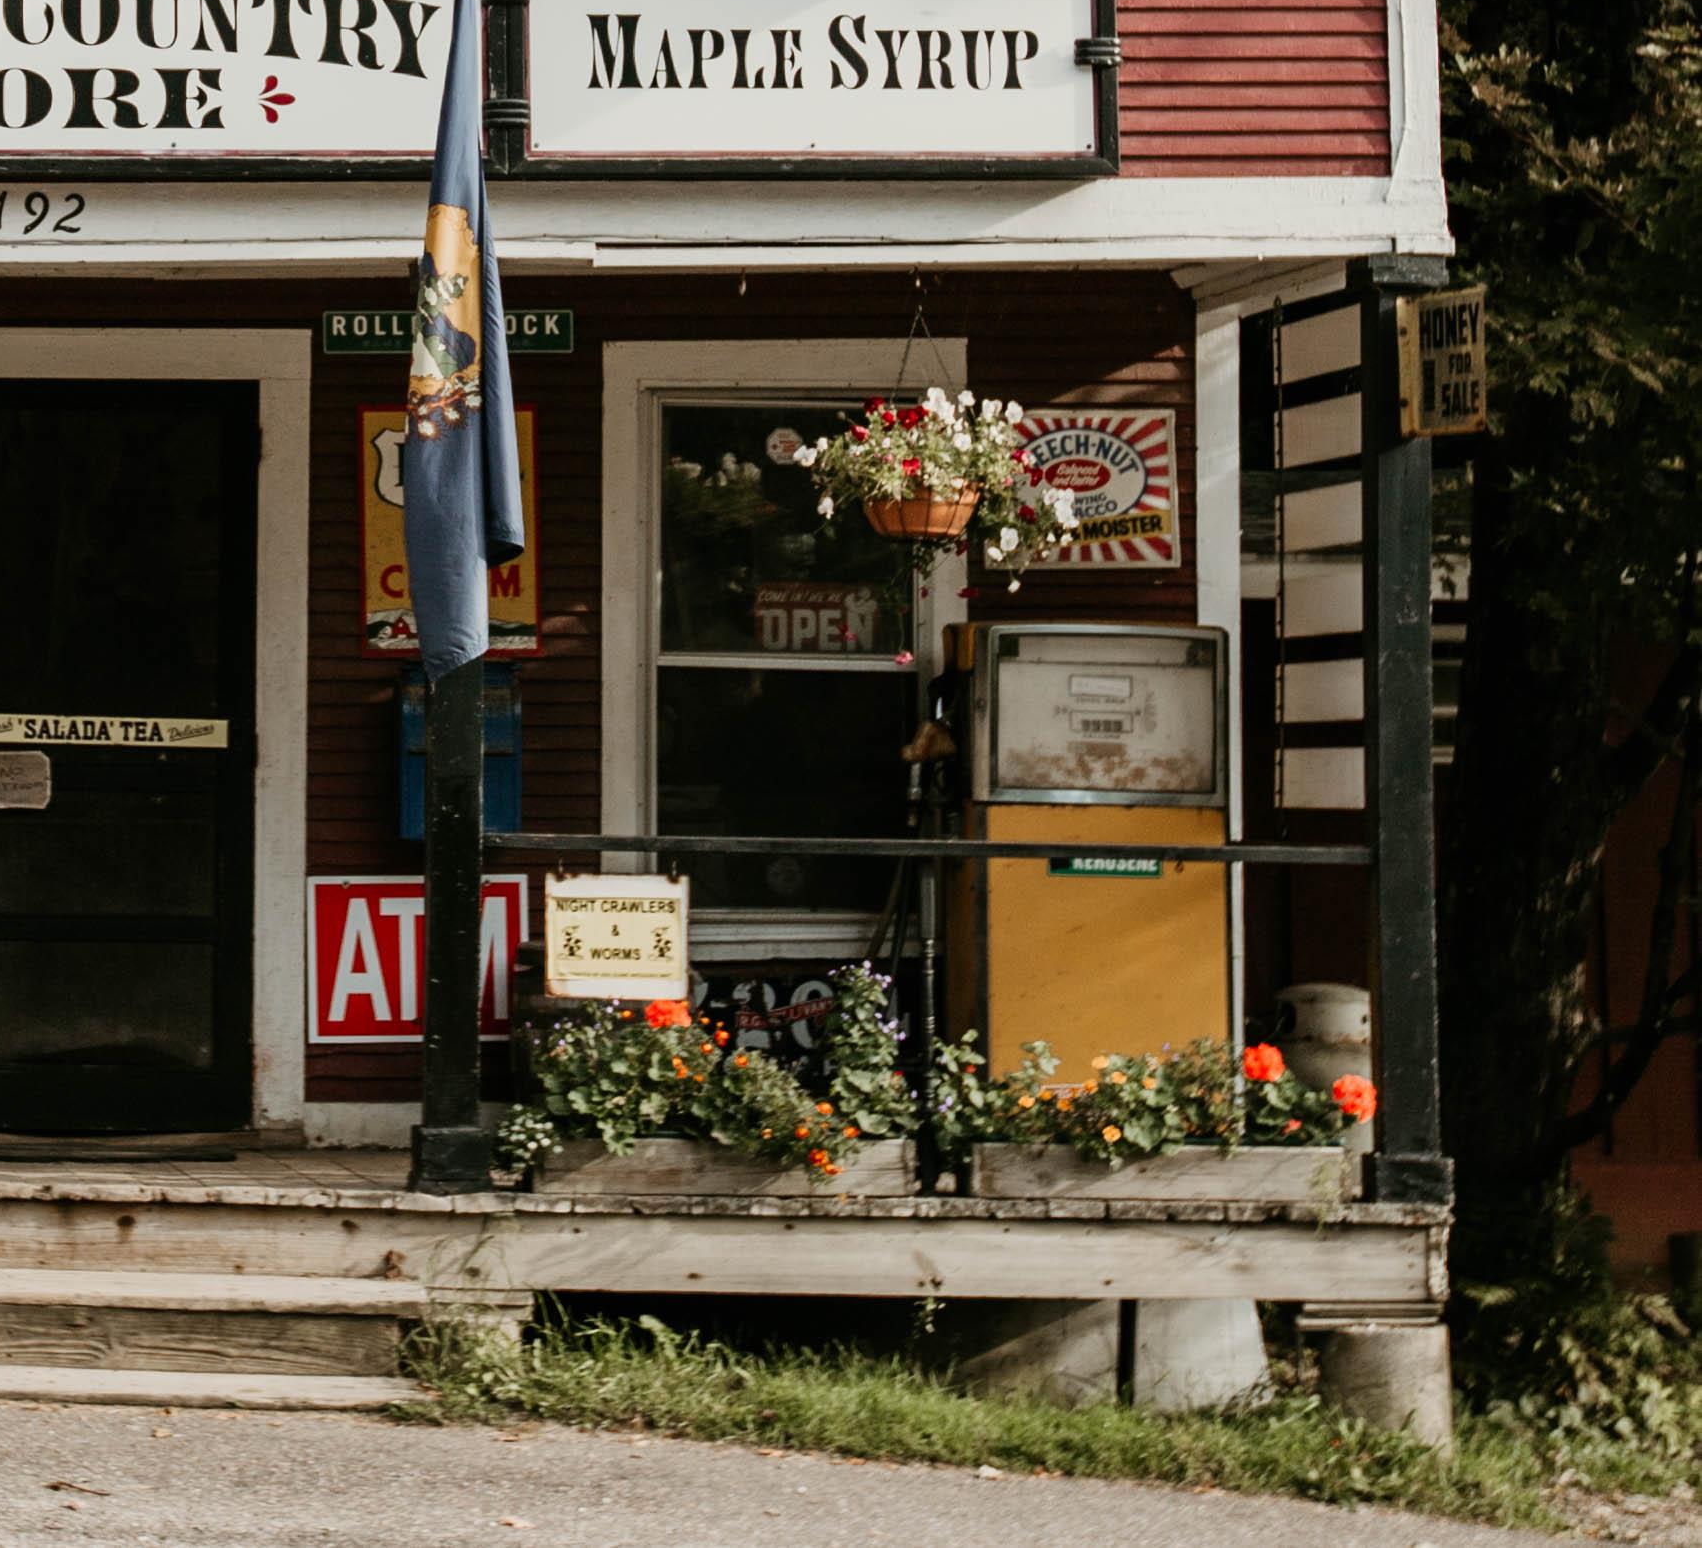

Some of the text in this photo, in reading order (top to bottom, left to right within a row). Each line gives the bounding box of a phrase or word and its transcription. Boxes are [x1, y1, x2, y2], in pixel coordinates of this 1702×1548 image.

[586, 14, 1040, 90] MAPLE SYRUP
[332, 314, 560, 336] ROLLI OCK
[1419, 301, 1480, 351] HONEY
[1449, 351, 1472, 374] FOR
[1441, 380, 1480, 418] SALE
[1033, 434, 1139, 475] EECH-NUT
[1072, 500, 1118, 519] ACCO
[1074, 492, 1107, 506] WING
[1082, 515, 1163, 540] MOISTER
[761, 608, 875, 651] OPEN
[119, 721, 164, 742] TEA
[556, 899, 676, 914] NIGHT CRAWLERS
[590, 948, 641, 960] WORMS
